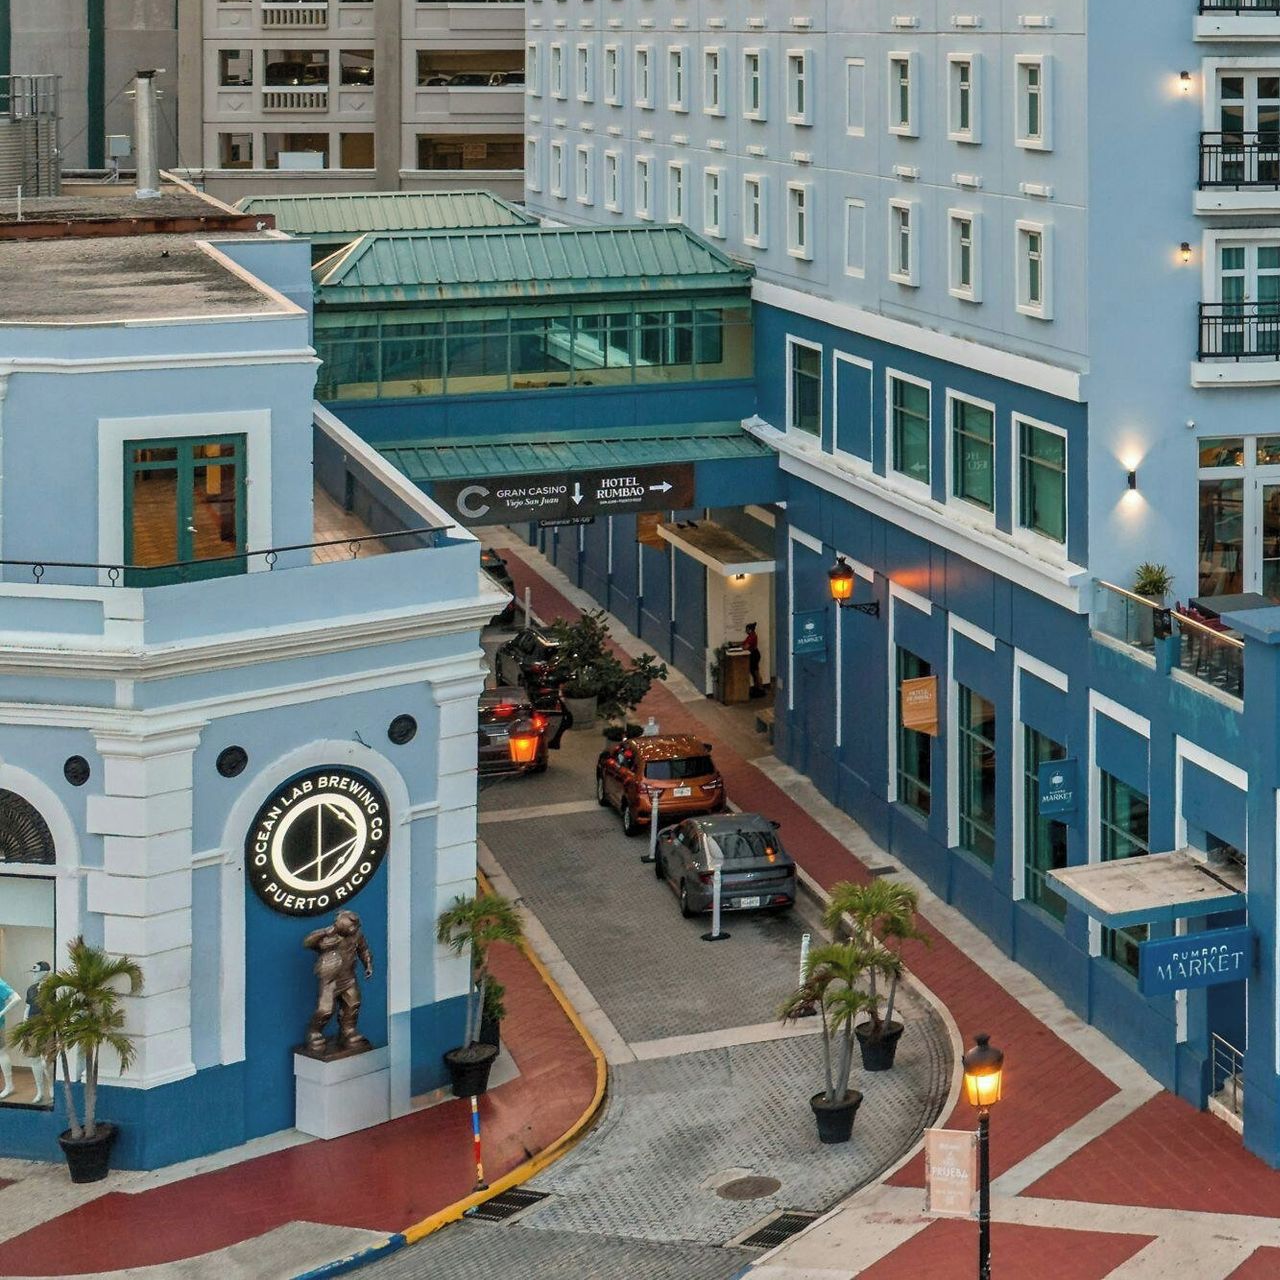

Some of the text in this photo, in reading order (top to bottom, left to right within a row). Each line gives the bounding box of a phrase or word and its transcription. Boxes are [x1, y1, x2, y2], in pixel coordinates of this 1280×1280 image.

[602, 477, 640, 488] HOTEL
[496, 485, 567, 498] GRAN CASINO
[597, 486, 645, 499] RUMBAO
[539, 496, 559, 506] Juan
[1041, 791, 1072, 802] MARKET
[255, 775, 383, 866] OCEAN LAB BREWING CO
[264, 861, 372, 910] PUERTO RICO
[1156, 951, 1244, 981] MARKET
[931, 1166, 969, 1178] PRUEBA
